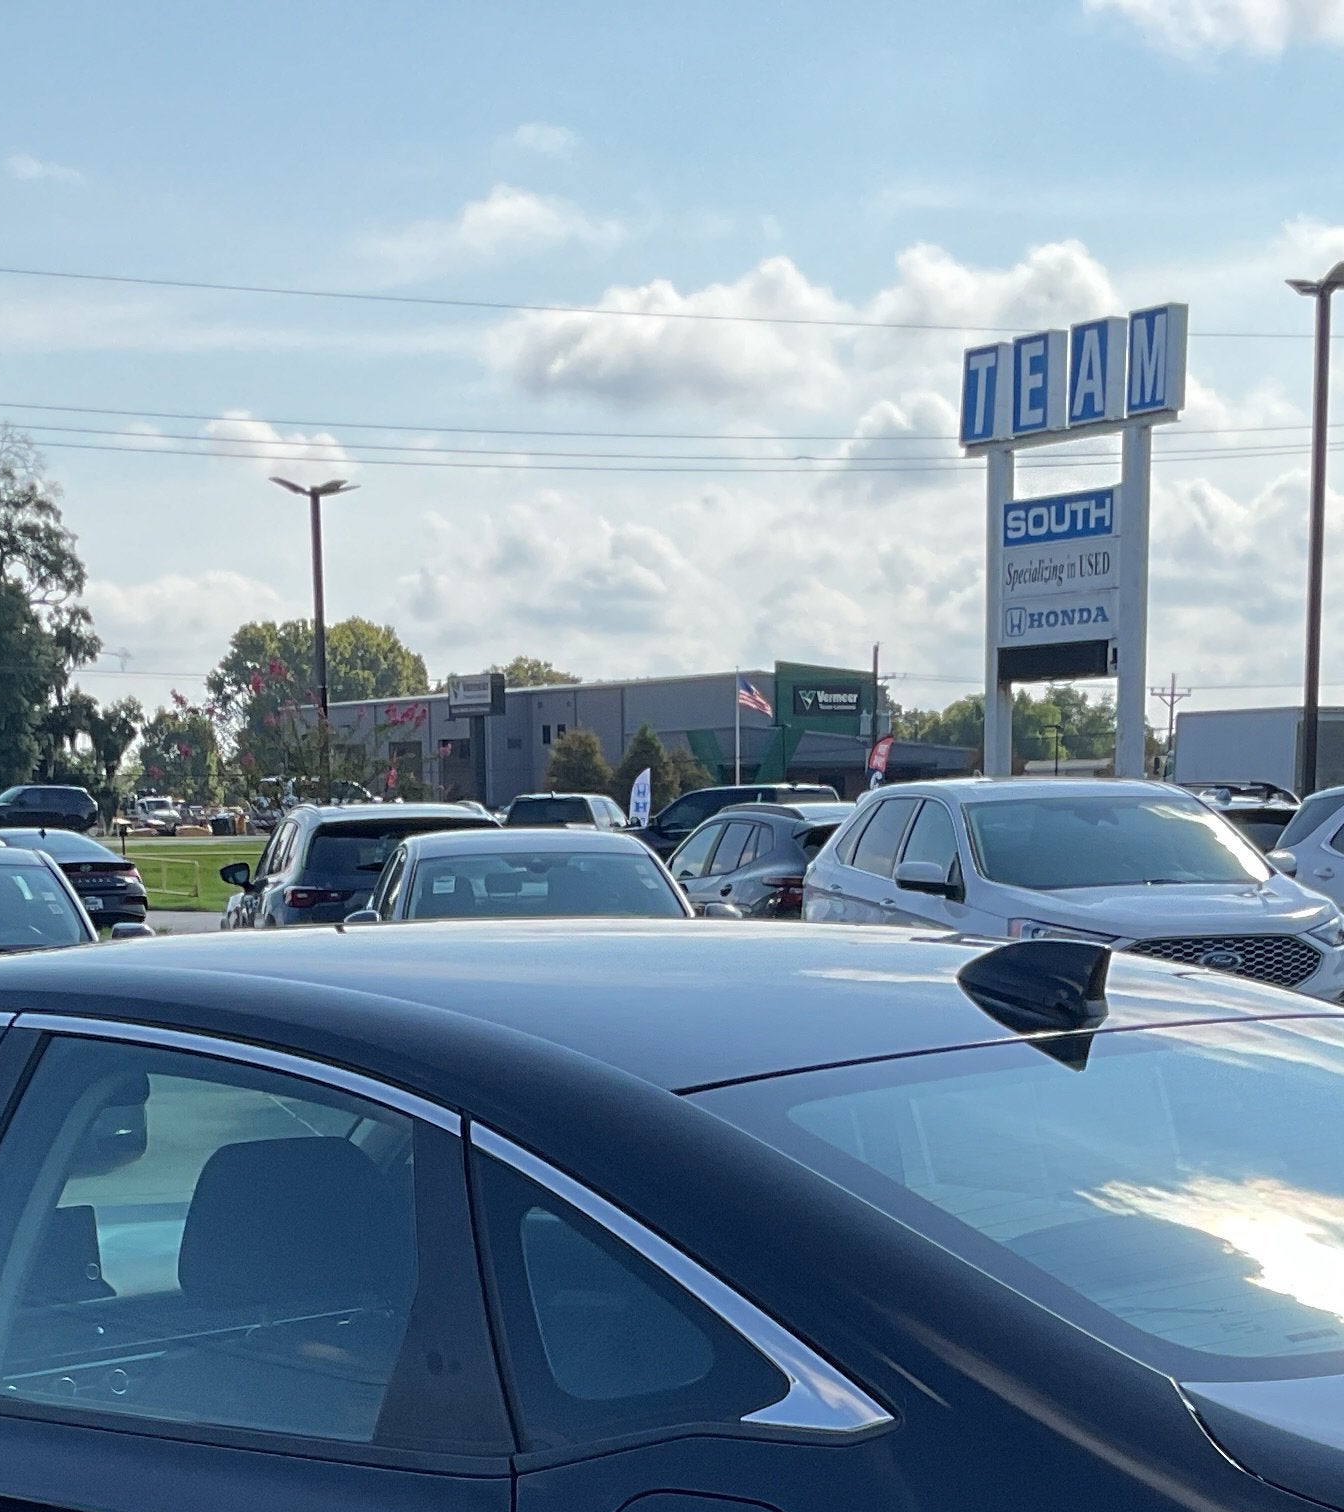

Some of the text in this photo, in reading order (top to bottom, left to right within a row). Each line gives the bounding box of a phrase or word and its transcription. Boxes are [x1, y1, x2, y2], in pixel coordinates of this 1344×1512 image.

[969, 313, 1167, 435] TEAM
[1006, 498, 1111, 539] SOUTH
[1005, 551, 1111, 592] Specializing in USED
[1028, 606, 1109, 629] HONDA
[816, 690, 858, 703] Vermeer
